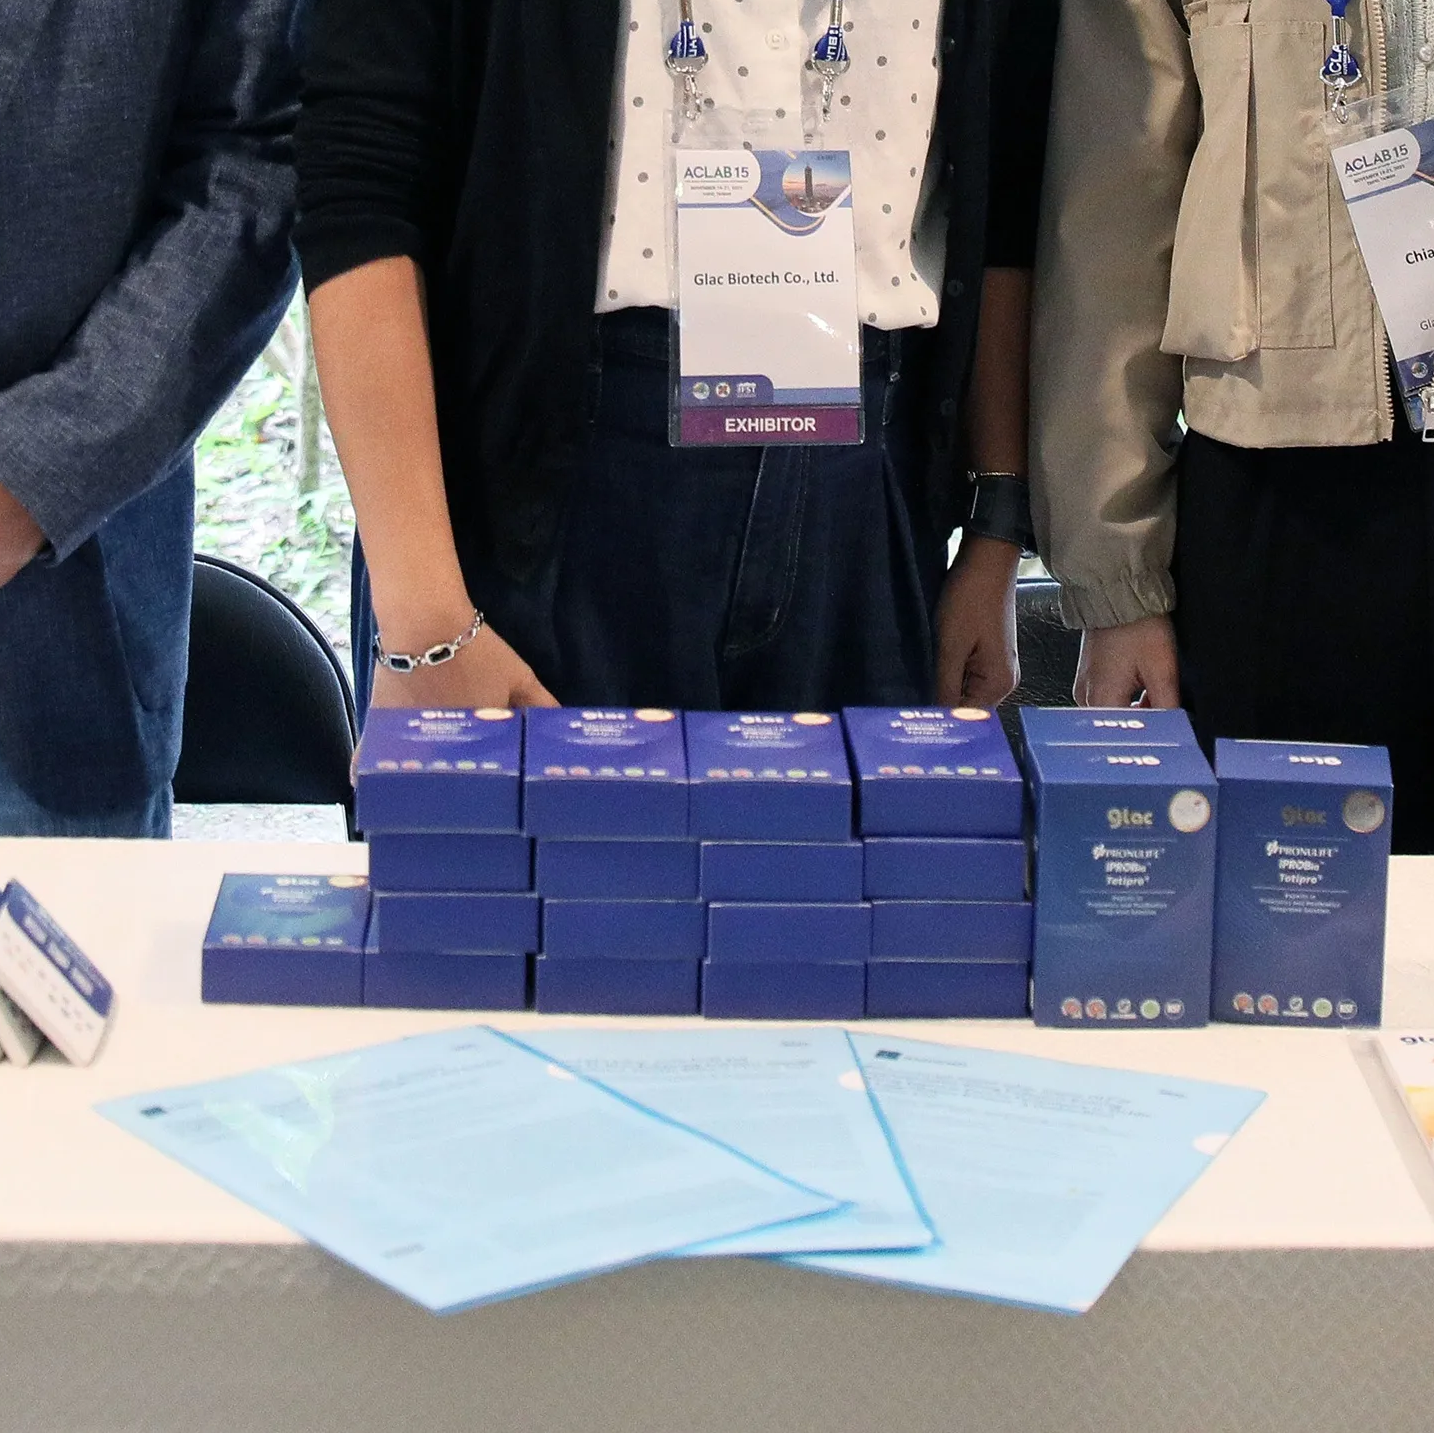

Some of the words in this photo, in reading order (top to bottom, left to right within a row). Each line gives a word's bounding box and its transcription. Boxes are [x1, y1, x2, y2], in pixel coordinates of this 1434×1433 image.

[1345, 149, 1391, 174] ACLAB
[1392, 144, 1408, 157] 15
[684, 166, 732, 178] ACLAB
[735, 166, 749, 178] 15
[1405, 248, 1434, 264] Chia
[694, 272, 724, 286] Glac
[728, 272, 780, 285] Biotech
[784, 272, 810, 285] Co.,
[814, 271, 839, 284] Ltd.
[725, 417, 817, 432] EXHIBITOR
